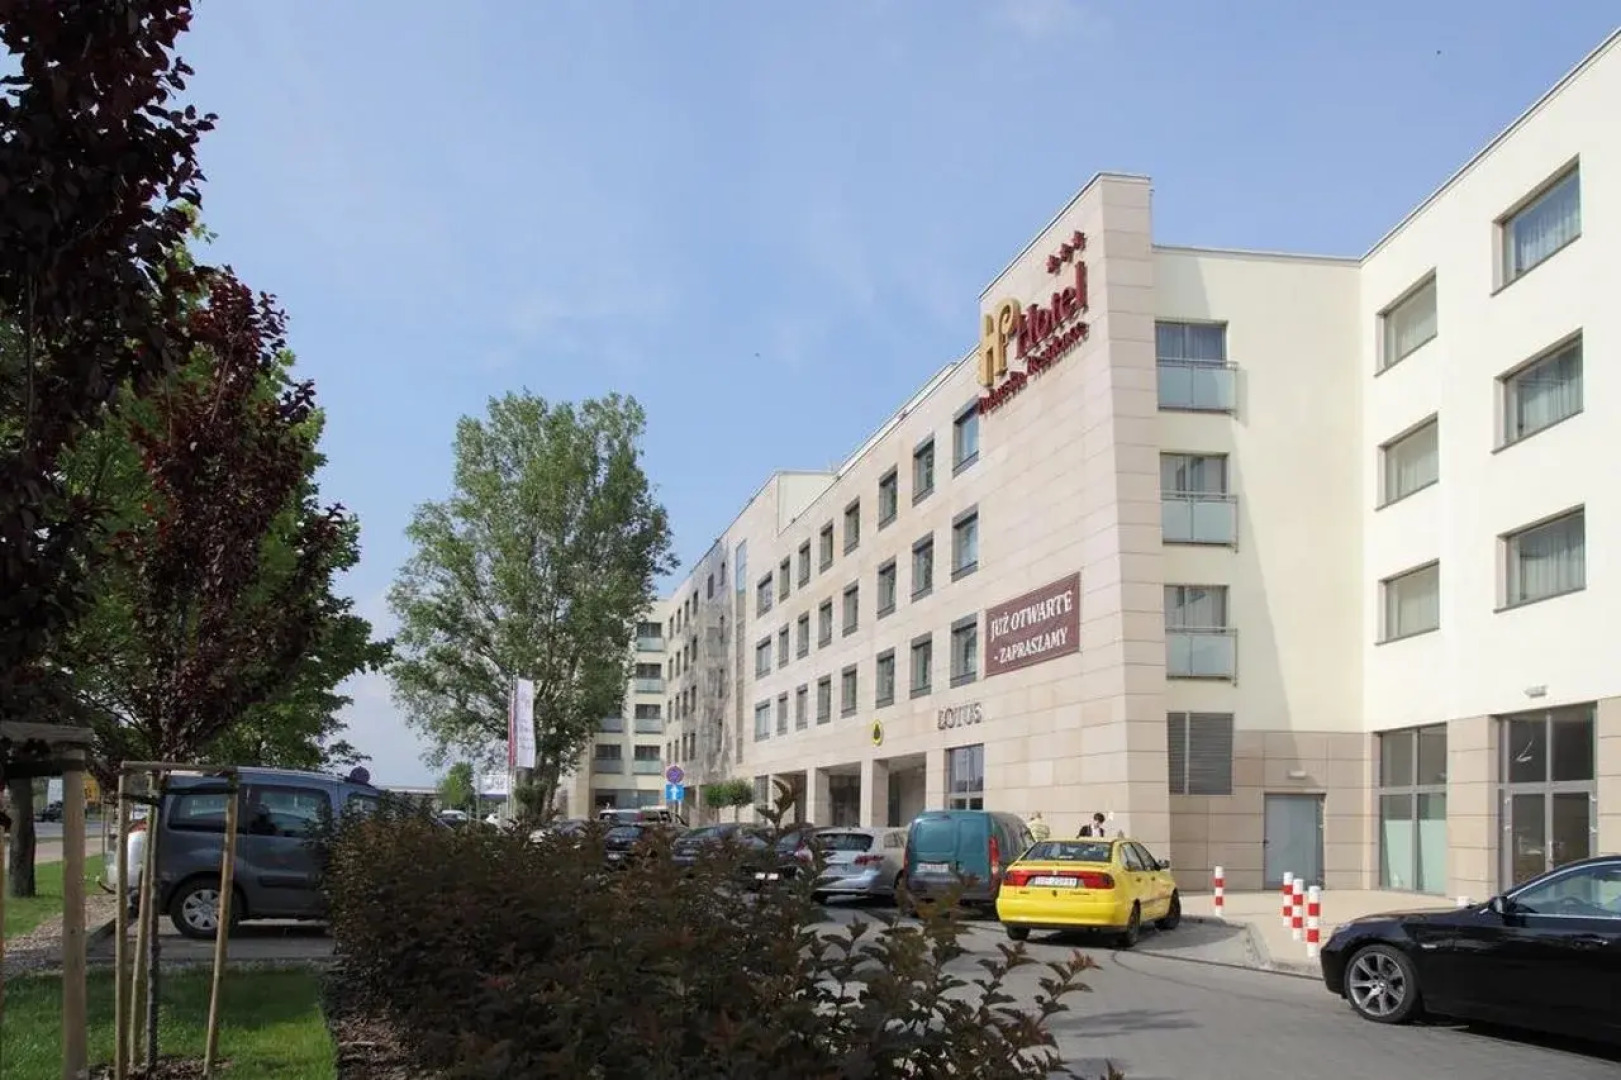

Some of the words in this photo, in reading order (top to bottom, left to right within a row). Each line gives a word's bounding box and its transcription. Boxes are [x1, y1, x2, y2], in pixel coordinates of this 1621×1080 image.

[1016, 260, 1088, 360] Hotel
[990, 611, 1010, 643] JUŻ
[1011, 589, 1073, 631] OTWARTE
[999, 626, 1068, 664] ZAPRASZAMY
[937, 702, 982, 730] LOTUS
